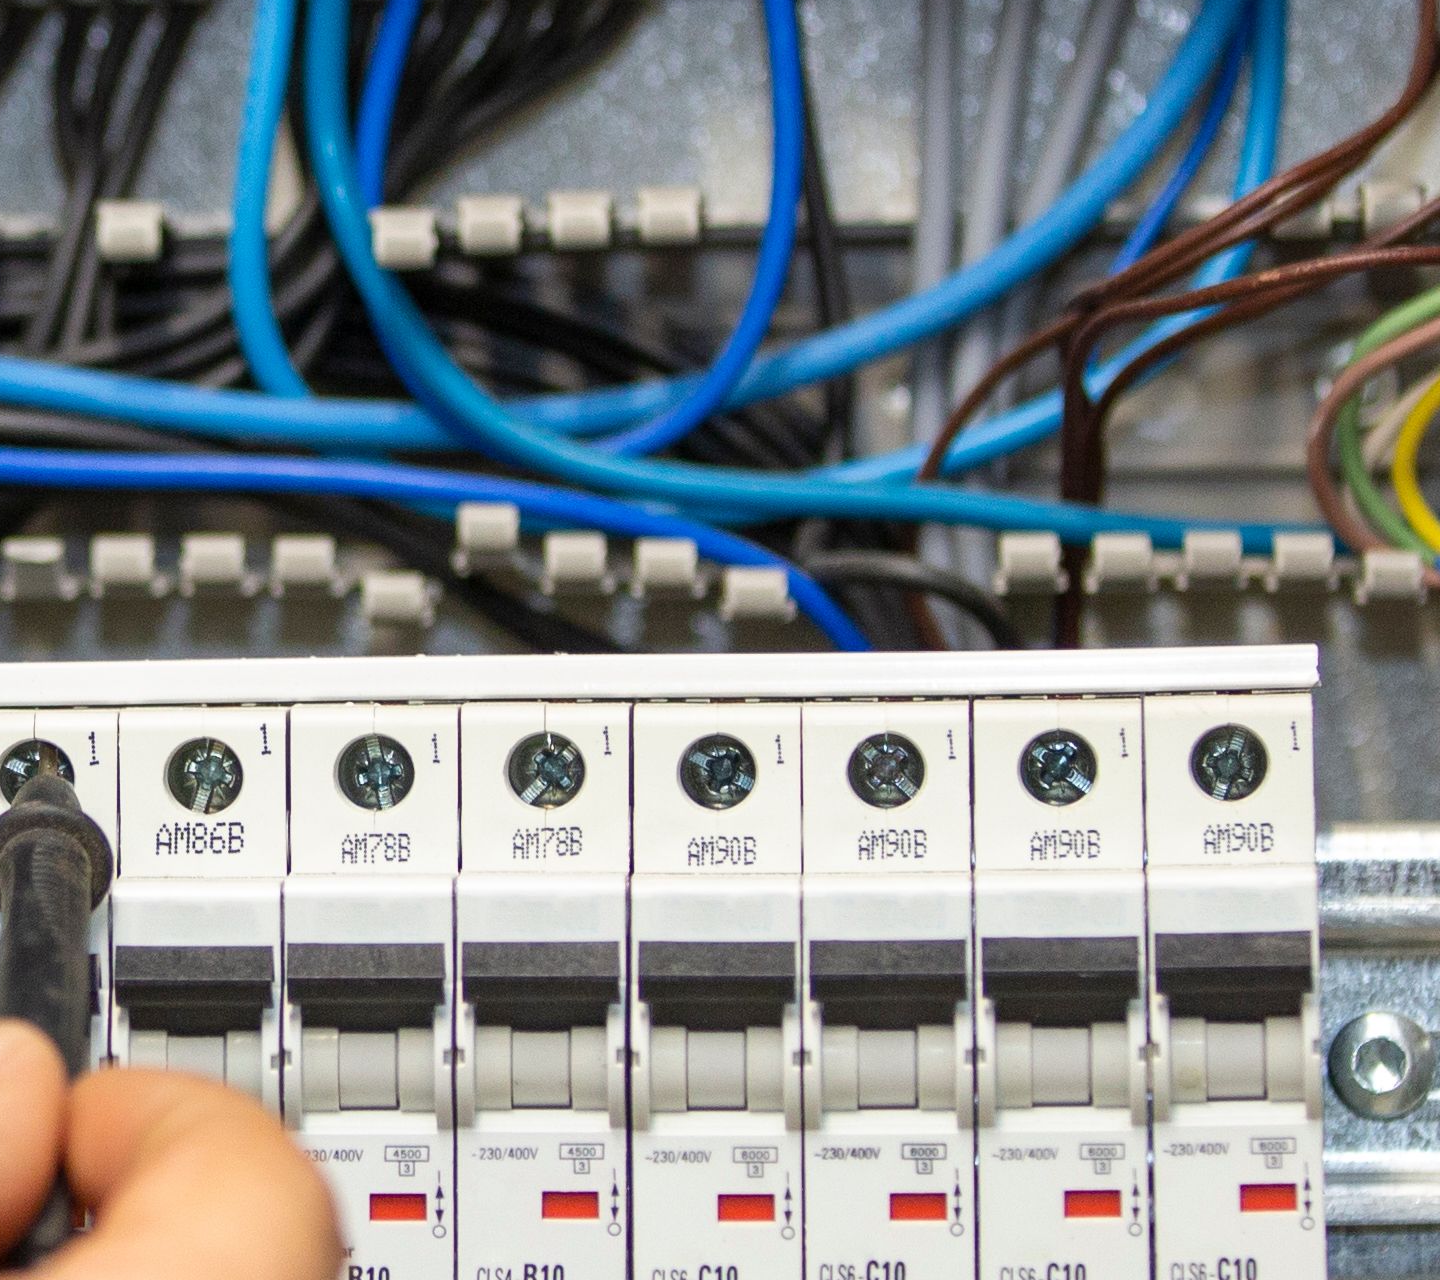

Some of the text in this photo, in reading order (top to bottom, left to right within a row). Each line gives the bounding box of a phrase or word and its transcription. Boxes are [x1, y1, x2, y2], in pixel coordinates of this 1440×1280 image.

[88, 732, 99, 766] 1
[260, 724, 271, 755] 1
[432, 734, 440, 763] 1
[603, 726, 612, 755] 1
[775, 735, 784, 764] 1
[947, 730, 956, 760] 1
[1119, 728, 1129, 758] 1
[1290, 721, 1300, 751] 1
[156, 822, 244, 855] AM86B
[342, 833, 410, 863] AM78B
[513, 826, 582, 859] AM78B
[688, 836, 756, 866] AM90B
[858, 829, 927, 860] AM90B
[1031, 829, 1100, 860] AM90B
[1204, 822, 1273, 853] AM90B
